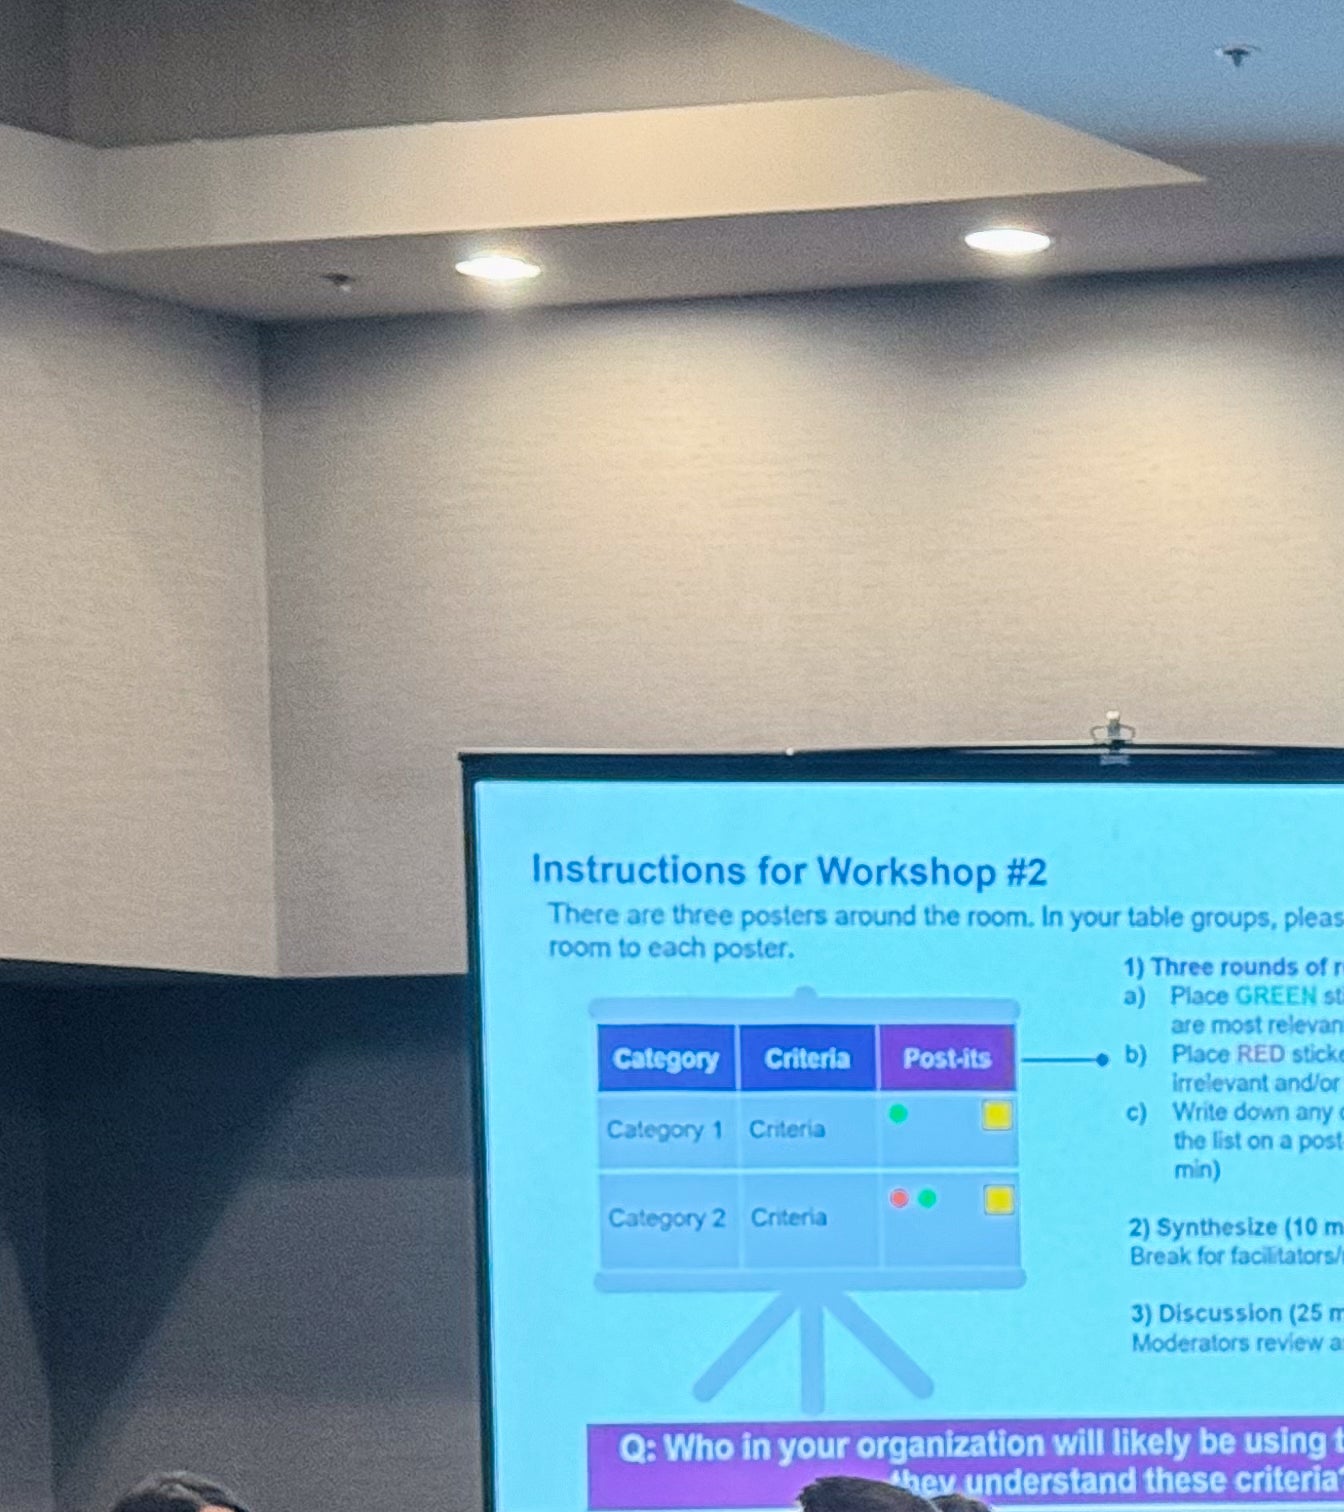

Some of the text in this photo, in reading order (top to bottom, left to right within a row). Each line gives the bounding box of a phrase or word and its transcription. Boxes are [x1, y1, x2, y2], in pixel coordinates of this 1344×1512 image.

[532, 852, 1048, 894] Instructions for Workshop #2
[546, 900, 620, 926] There
[626, 907, 665, 927] are
[671, 903, 734, 927] three
[740, 903, 829, 933] posters
[834, 904, 917, 928] around
[923, 903, 961, 927] the
[966, 909, 1036, 929] room.
[1041, 904, 1064, 928] In
[1069, 909, 1123, 933] your
[1127, 904, 1185, 929] table
[1190, 910, 1278, 934] groups,
[549, 935, 795, 965] room to each poster.
[1124, 956, 1145, 982] 1)
[1149, 956, 1214, 977] Three
[1220, 956, 1299, 977] rounds
[1304, 956, 1329, 977] of
[1122, 985, 1146, 1010] a)
[1170, 984, 1230, 1007] Place
[1234, 984, 1318, 1007] GREEN
[1170, 1018, 1206, 1036] are
[1210, 1015, 1264, 1036] most
[612, 1046, 721, 1075] Category
[764, 1046, 851, 1070] Criteria
[903, 1046, 993, 1070] Post-its
[1124, 1043, 1148, 1069] b)
[1171, 1043, 1231, 1065] Place
[1235, 1044, 1286, 1064] RED
[1171, 1071, 1270, 1094] irrelevant
[1273, 1071, 1342, 1094] and/or
[1125, 1101, 1148, 1127] c)
[1171, 1100, 1229, 1124] Write
[1233, 1100, 1290, 1122] down
[1295, 1105, 1335, 1127] any
[605, 1118, 722, 1146] Category 1
[748, 1118, 827, 1141] Criteria
[1173, 1129, 1207, 1151] the
[1212, 1129, 1243, 1151] list
[1246, 1134, 1274, 1151] on
[1279, 1133, 1293, 1151] a
[1174, 1157, 1221, 1184] min)
[607, 1206, 727, 1233] Category 2
[750, 1206, 828, 1229] Criteria
[1128, 1216, 1151, 1243] 2)
[1156, 1216, 1279, 1243] Synthesize
[1284, 1216, 1318, 1242] (10
[1130, 1244, 1193, 1267] Break
[1196, 1244, 1226, 1267] for
[1131, 1303, 1153, 1328] 3)
[1158, 1301, 1283, 1324] Discussion
[1288, 1301, 1323, 1328] (25
[1132, 1331, 1251, 1354] Moderators
[1255, 1331, 1325, 1353] review
[619, 1432, 657, 1464] Q:
[663, 1433, 734, 1461] Who
[742, 1431, 771, 1461] in
[778, 1437, 849, 1467] your
[856, 1429, 1045, 1464] organization
[1053, 1428, 1104, 1456] will
[1112, 1427, 1192, 1461] likely
[1199, 1426, 1236, 1454] be
[1244, 1426, 1326, 1460] using
[965, 1467, 1137, 1496] understand
[1144, 1466, 1226, 1494] these
